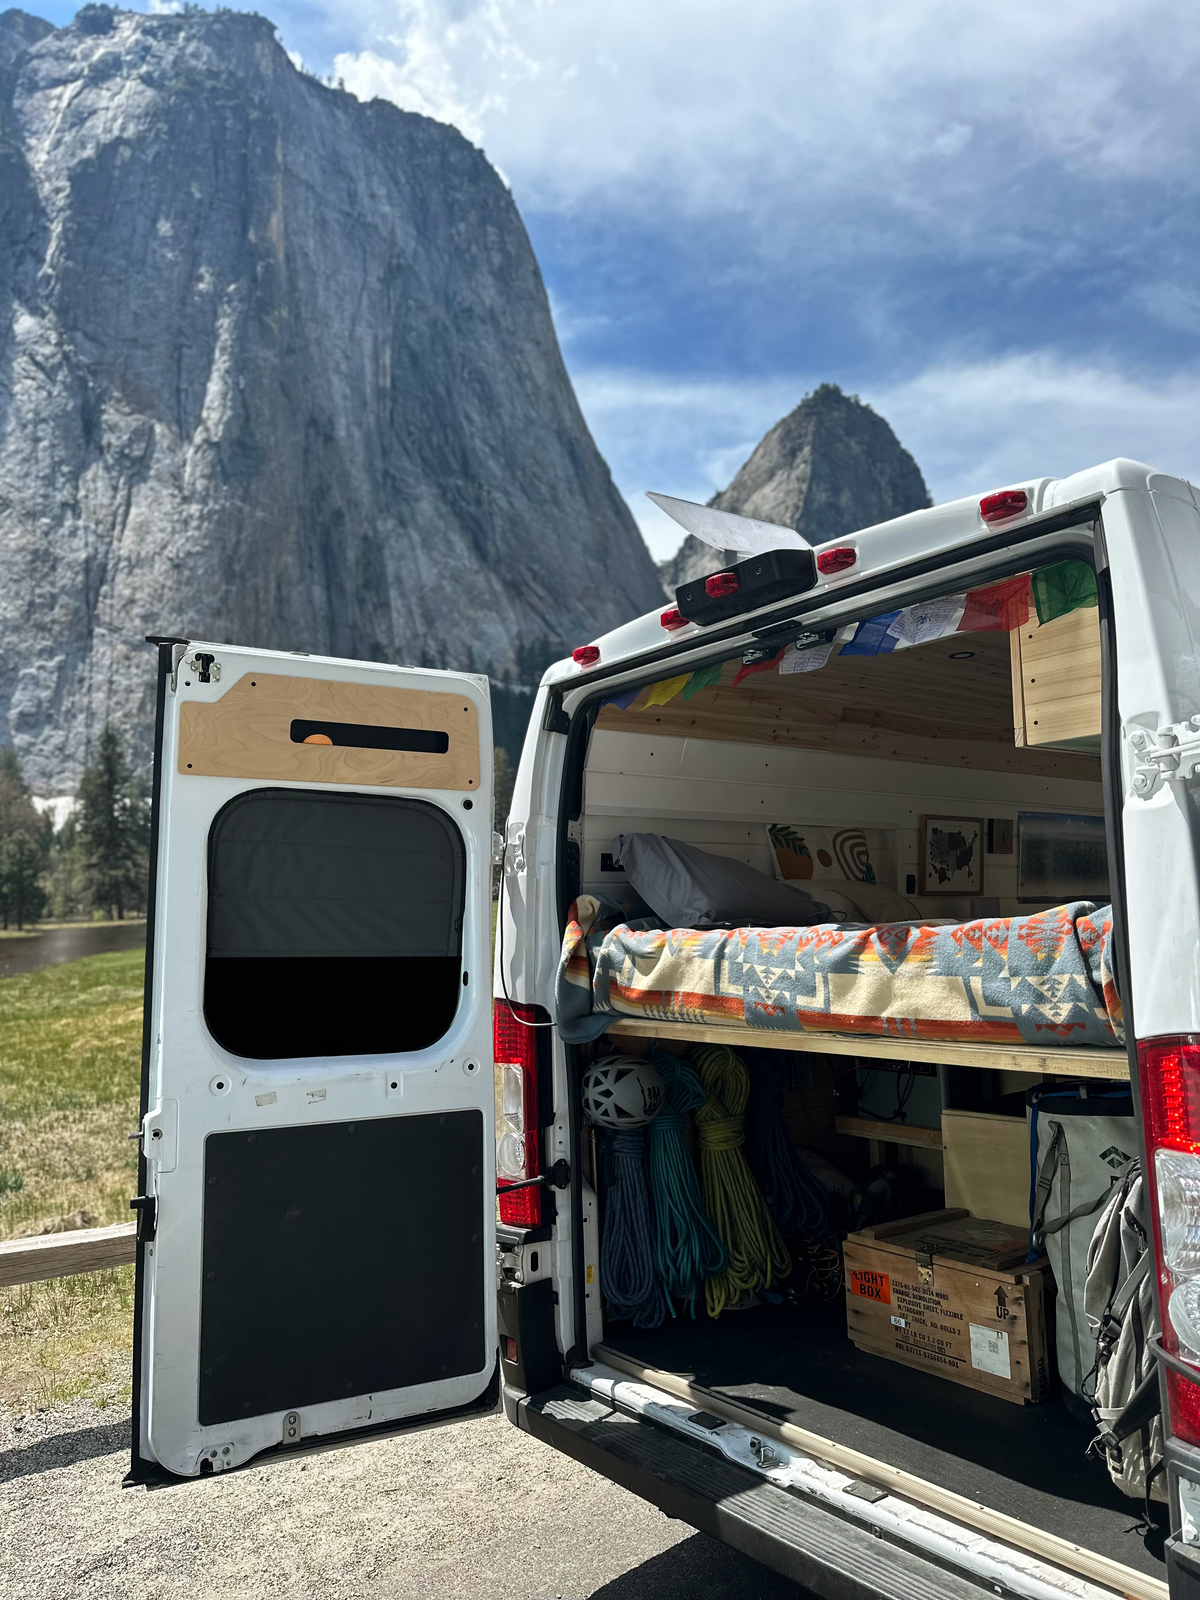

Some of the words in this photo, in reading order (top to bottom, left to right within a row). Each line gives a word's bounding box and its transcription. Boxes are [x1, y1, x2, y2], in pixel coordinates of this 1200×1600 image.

[860, 1284, 882, 1300] BOX
[893, 1288, 911, 1298] CHARGE,
[897, 1297, 921, 1308] EXPLOSIVE
[923, 1303, 939, 1314] SHEET,
[940, 1309, 964, 1320] FLEXIBLE
[996, 1306, 1009, 1319] UP
[940, 1325, 956, 1334] ROLLS
[927, 1335, 936, 1343] 2.2
[945, 1341, 952, 1349] FT
